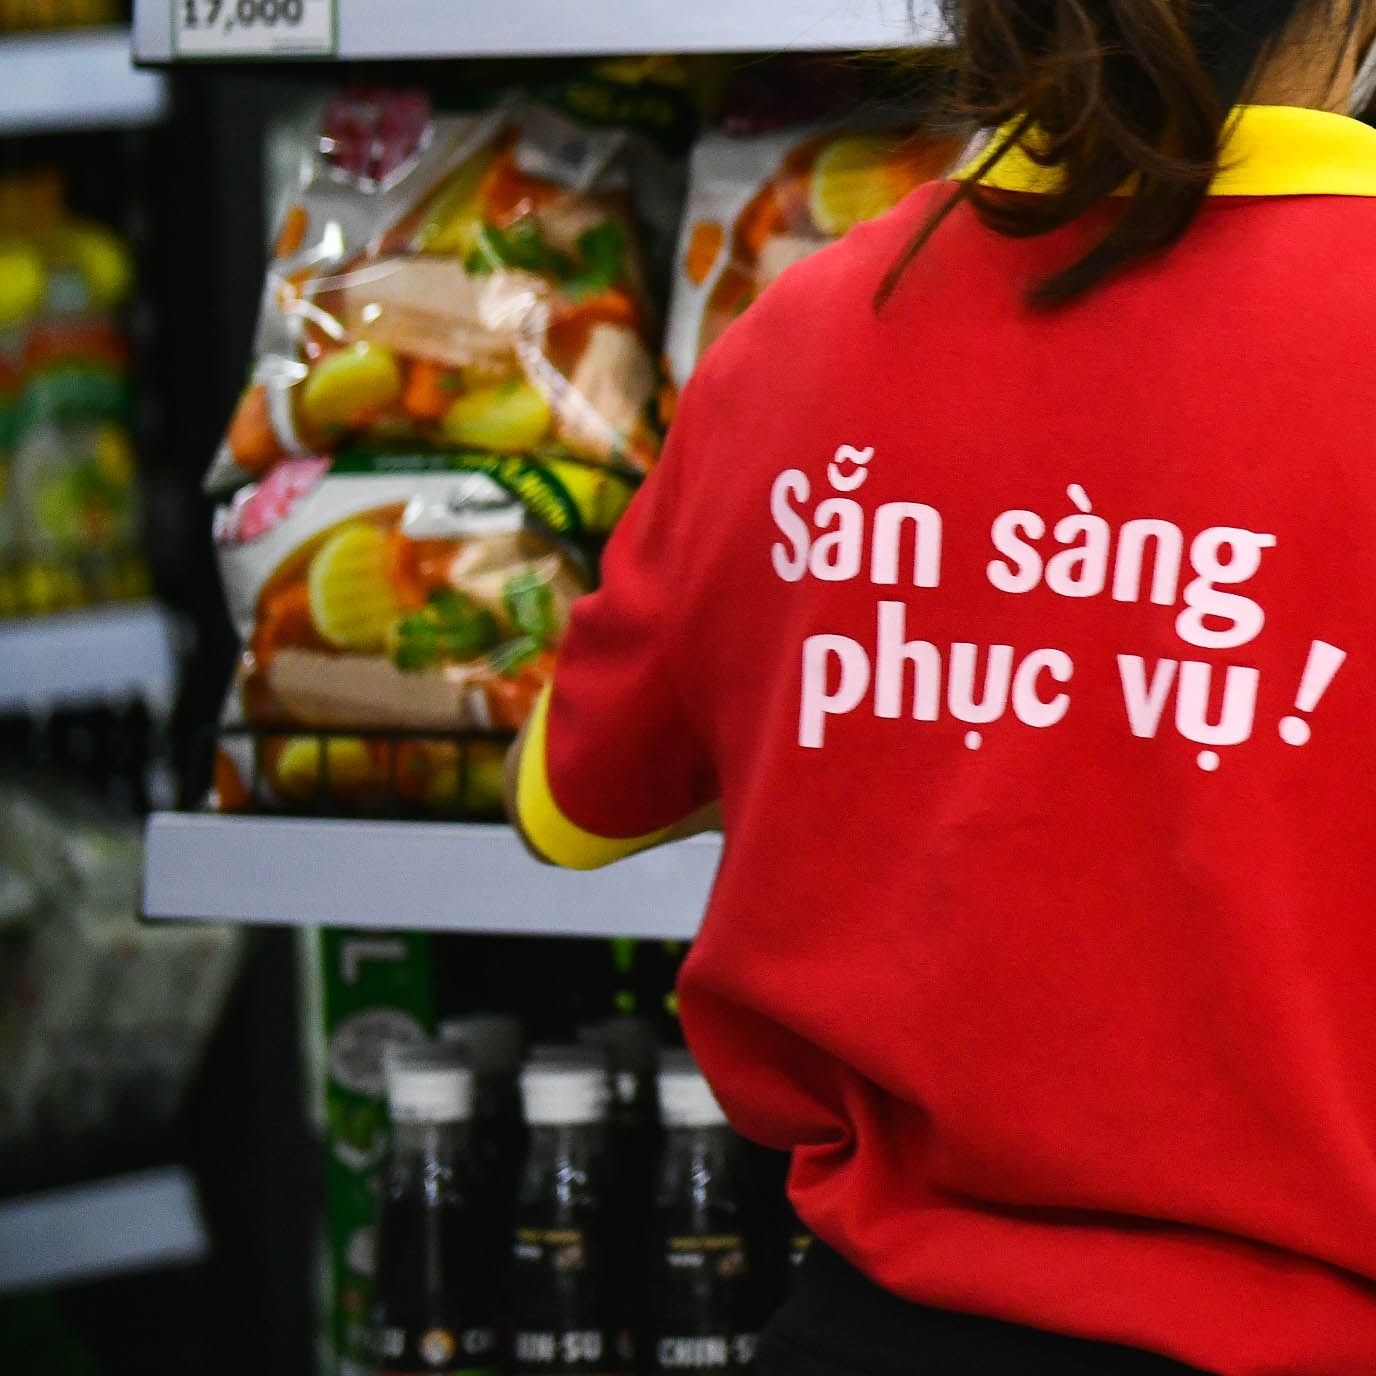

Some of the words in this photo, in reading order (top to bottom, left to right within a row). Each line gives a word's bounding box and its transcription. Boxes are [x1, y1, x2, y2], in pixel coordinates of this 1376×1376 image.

[771, 444, 942, 587] Sẵn
[986, 483, 1276, 648] sàng
[798, 600, 1073, 749] phục
[1117, 653, 1259, 771] vụ
